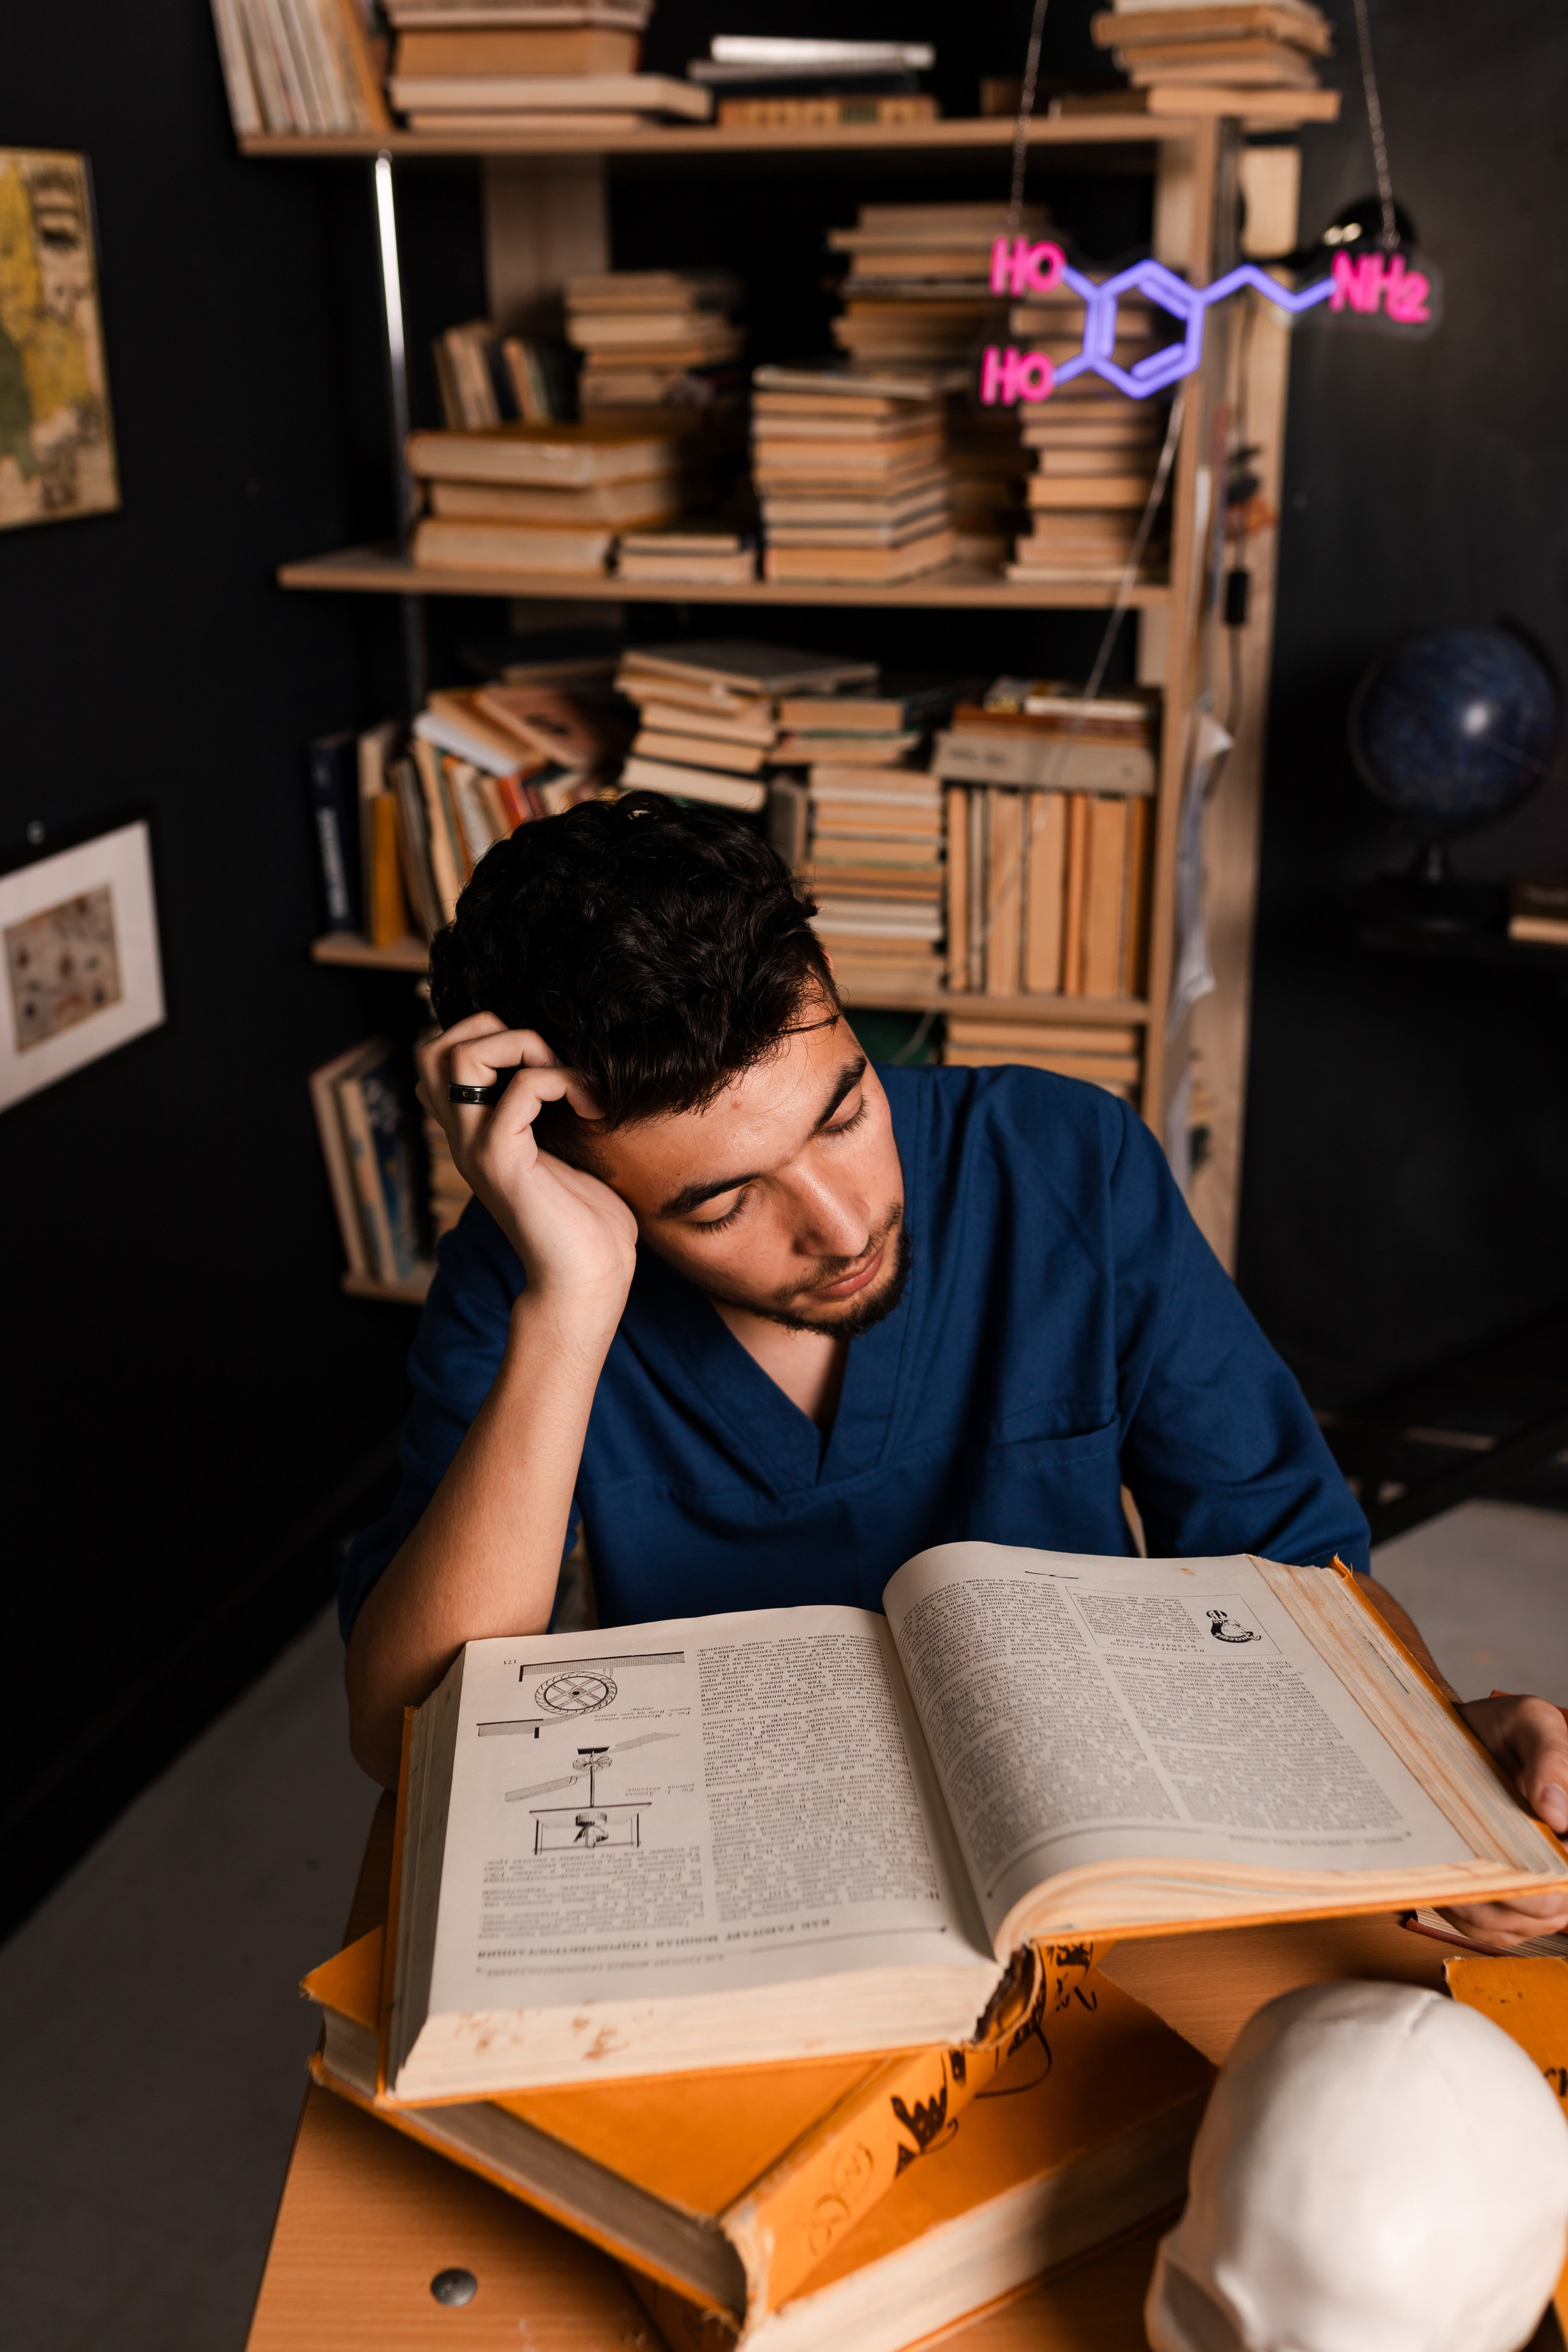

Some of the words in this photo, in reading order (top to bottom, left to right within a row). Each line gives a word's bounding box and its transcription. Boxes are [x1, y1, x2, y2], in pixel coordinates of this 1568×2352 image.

[990, 235, 1067, 296] HO
[1330, 251, 1432, 323] NH2
[982, 345, 1056, 405] HO
